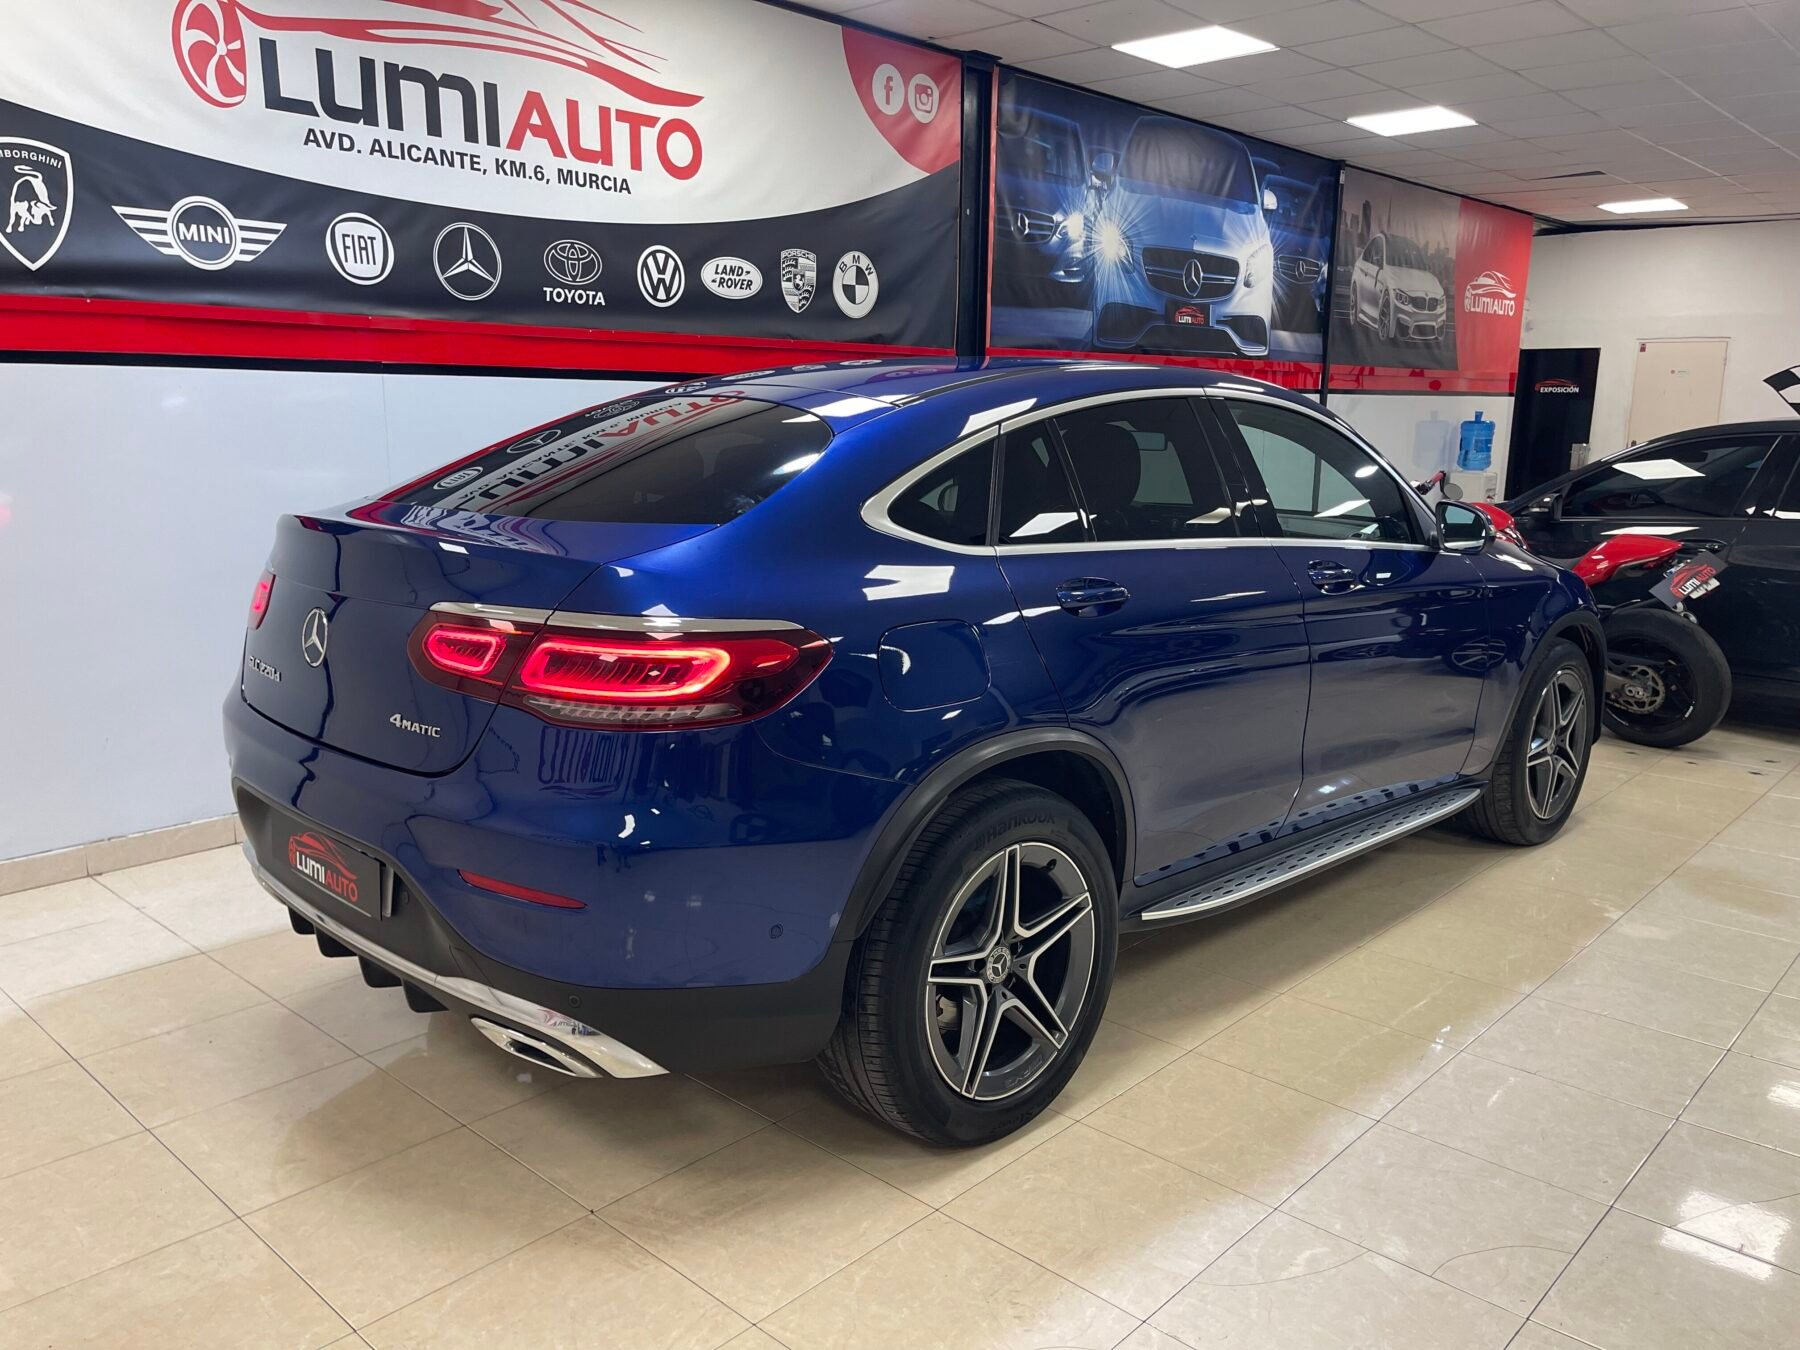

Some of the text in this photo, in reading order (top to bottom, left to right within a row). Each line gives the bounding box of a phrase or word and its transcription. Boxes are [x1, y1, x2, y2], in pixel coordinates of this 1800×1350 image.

[303, 127, 632, 194] AVD. ALICANTE, KM.6, MURCIA
[178, 222, 231, 245] MINI
[341, 233, 377, 266] FIAT
[782, 249, 816, 263] PORSCHE
[838, 254, 874, 276] BMW
[543, 287, 606, 306] TOYOTA
[1470, 295, 1515, 317] LUMIAUTO
[1540, 385, 1580, 393] EXPOSICIÓN
[1678, 566, 1717, 596] LUMIAUTO
[389, 713, 441, 738] 4MATIC
[296, 851, 358, 902] LUMIAUTO
